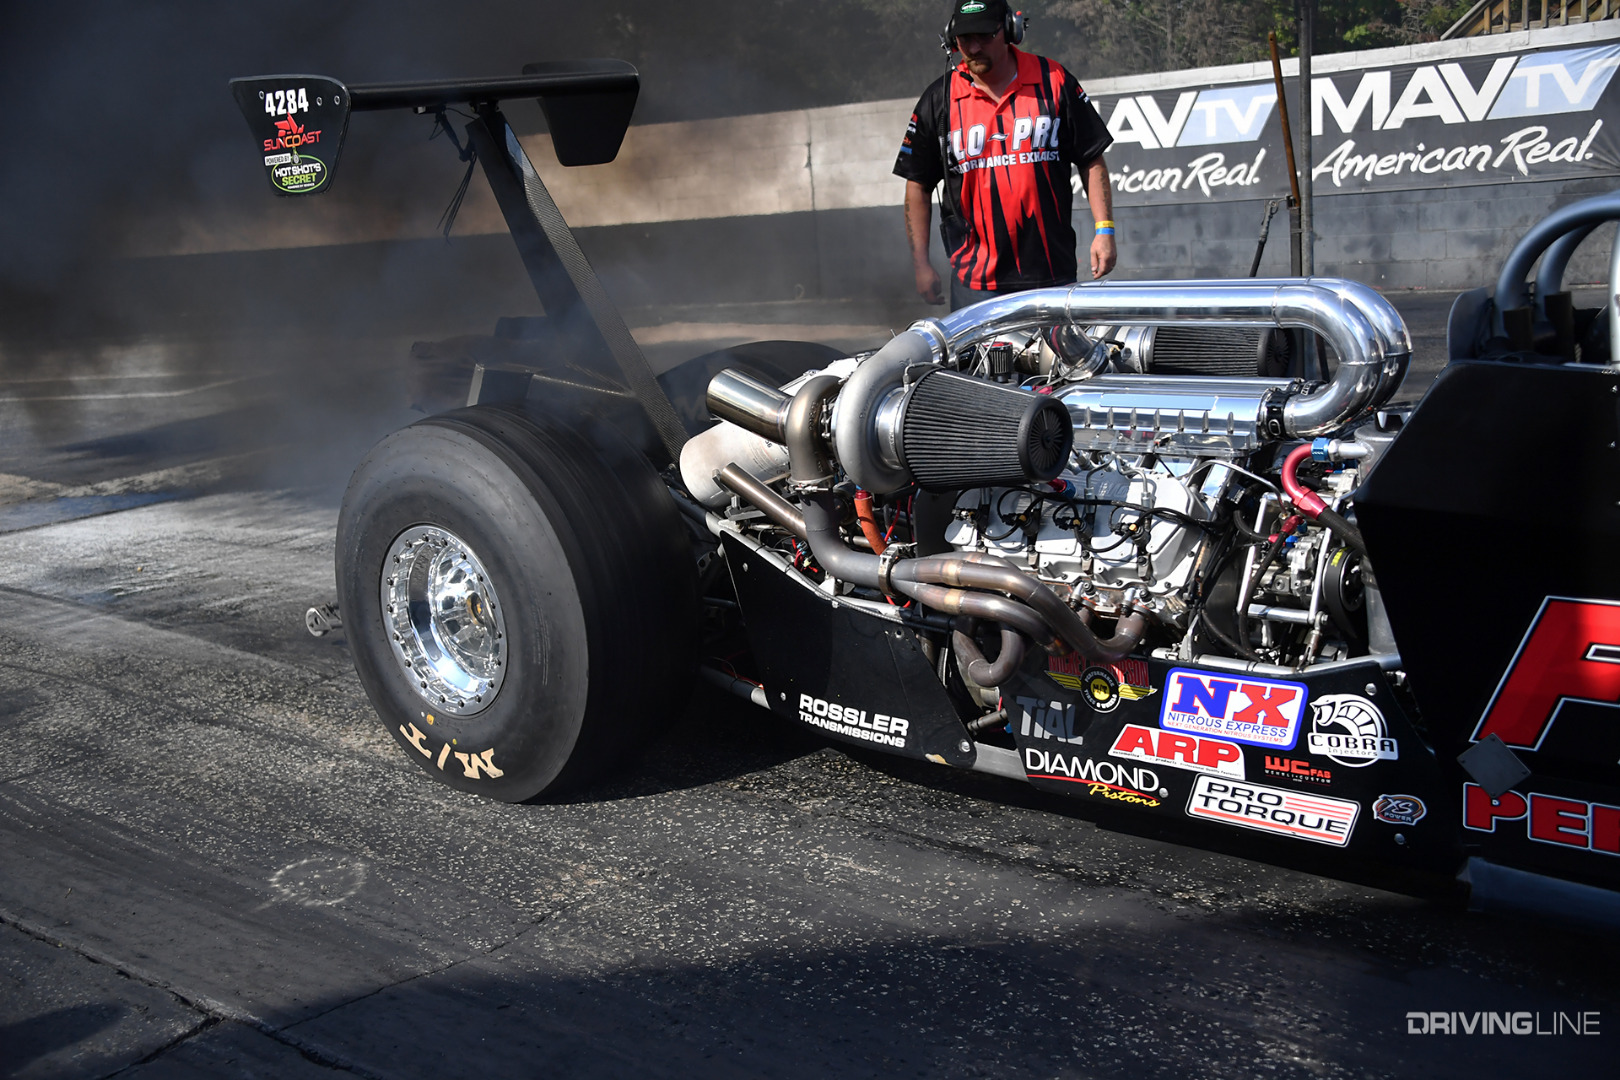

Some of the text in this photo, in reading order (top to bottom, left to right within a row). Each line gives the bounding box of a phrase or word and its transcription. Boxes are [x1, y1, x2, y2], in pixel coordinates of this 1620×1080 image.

[264, 88, 309, 117] 4284
[1311, 55, 1619, 137] MAVTV
[1091, 90, 1278, 153] AVTV
[264, 130, 322, 152] SUNCOAST
[1311, 119, 1604, 188] American Real.
[265, 154, 291, 165] POWERED BY
[275, 163, 321, 178] HOT SHOT'S
[1182, 148, 1267, 198] Real.
[281, 173, 317, 187] SECRET
[799, 693, 909, 737] ROSSLER
[1171, 675, 1298, 729] NX
[798, 711, 906, 748] TRANSMISSIONS
[1167, 711, 1288, 739] NITROUS EXPRESS
[1184, 723, 1223, 735] GENERATION
[1223, 730, 1252, 739] NITROUS
[1253, 734, 1284, 743] SYSTEMS
[1114, 726, 1241, 768] ARP
[1310, 734, 1395, 753] COBRA
[1327, 746, 1378, 757] Injectors
[1025, 748, 1160, 792] DIAMOND
[1087, 782, 1161, 808] Pistons
[1206, 781, 1284, 807] PRO
[1379, 798, 1413, 814] XS
[1197, 793, 1350, 836] TORQUE
[1384, 811, 1412, 823] POWER
